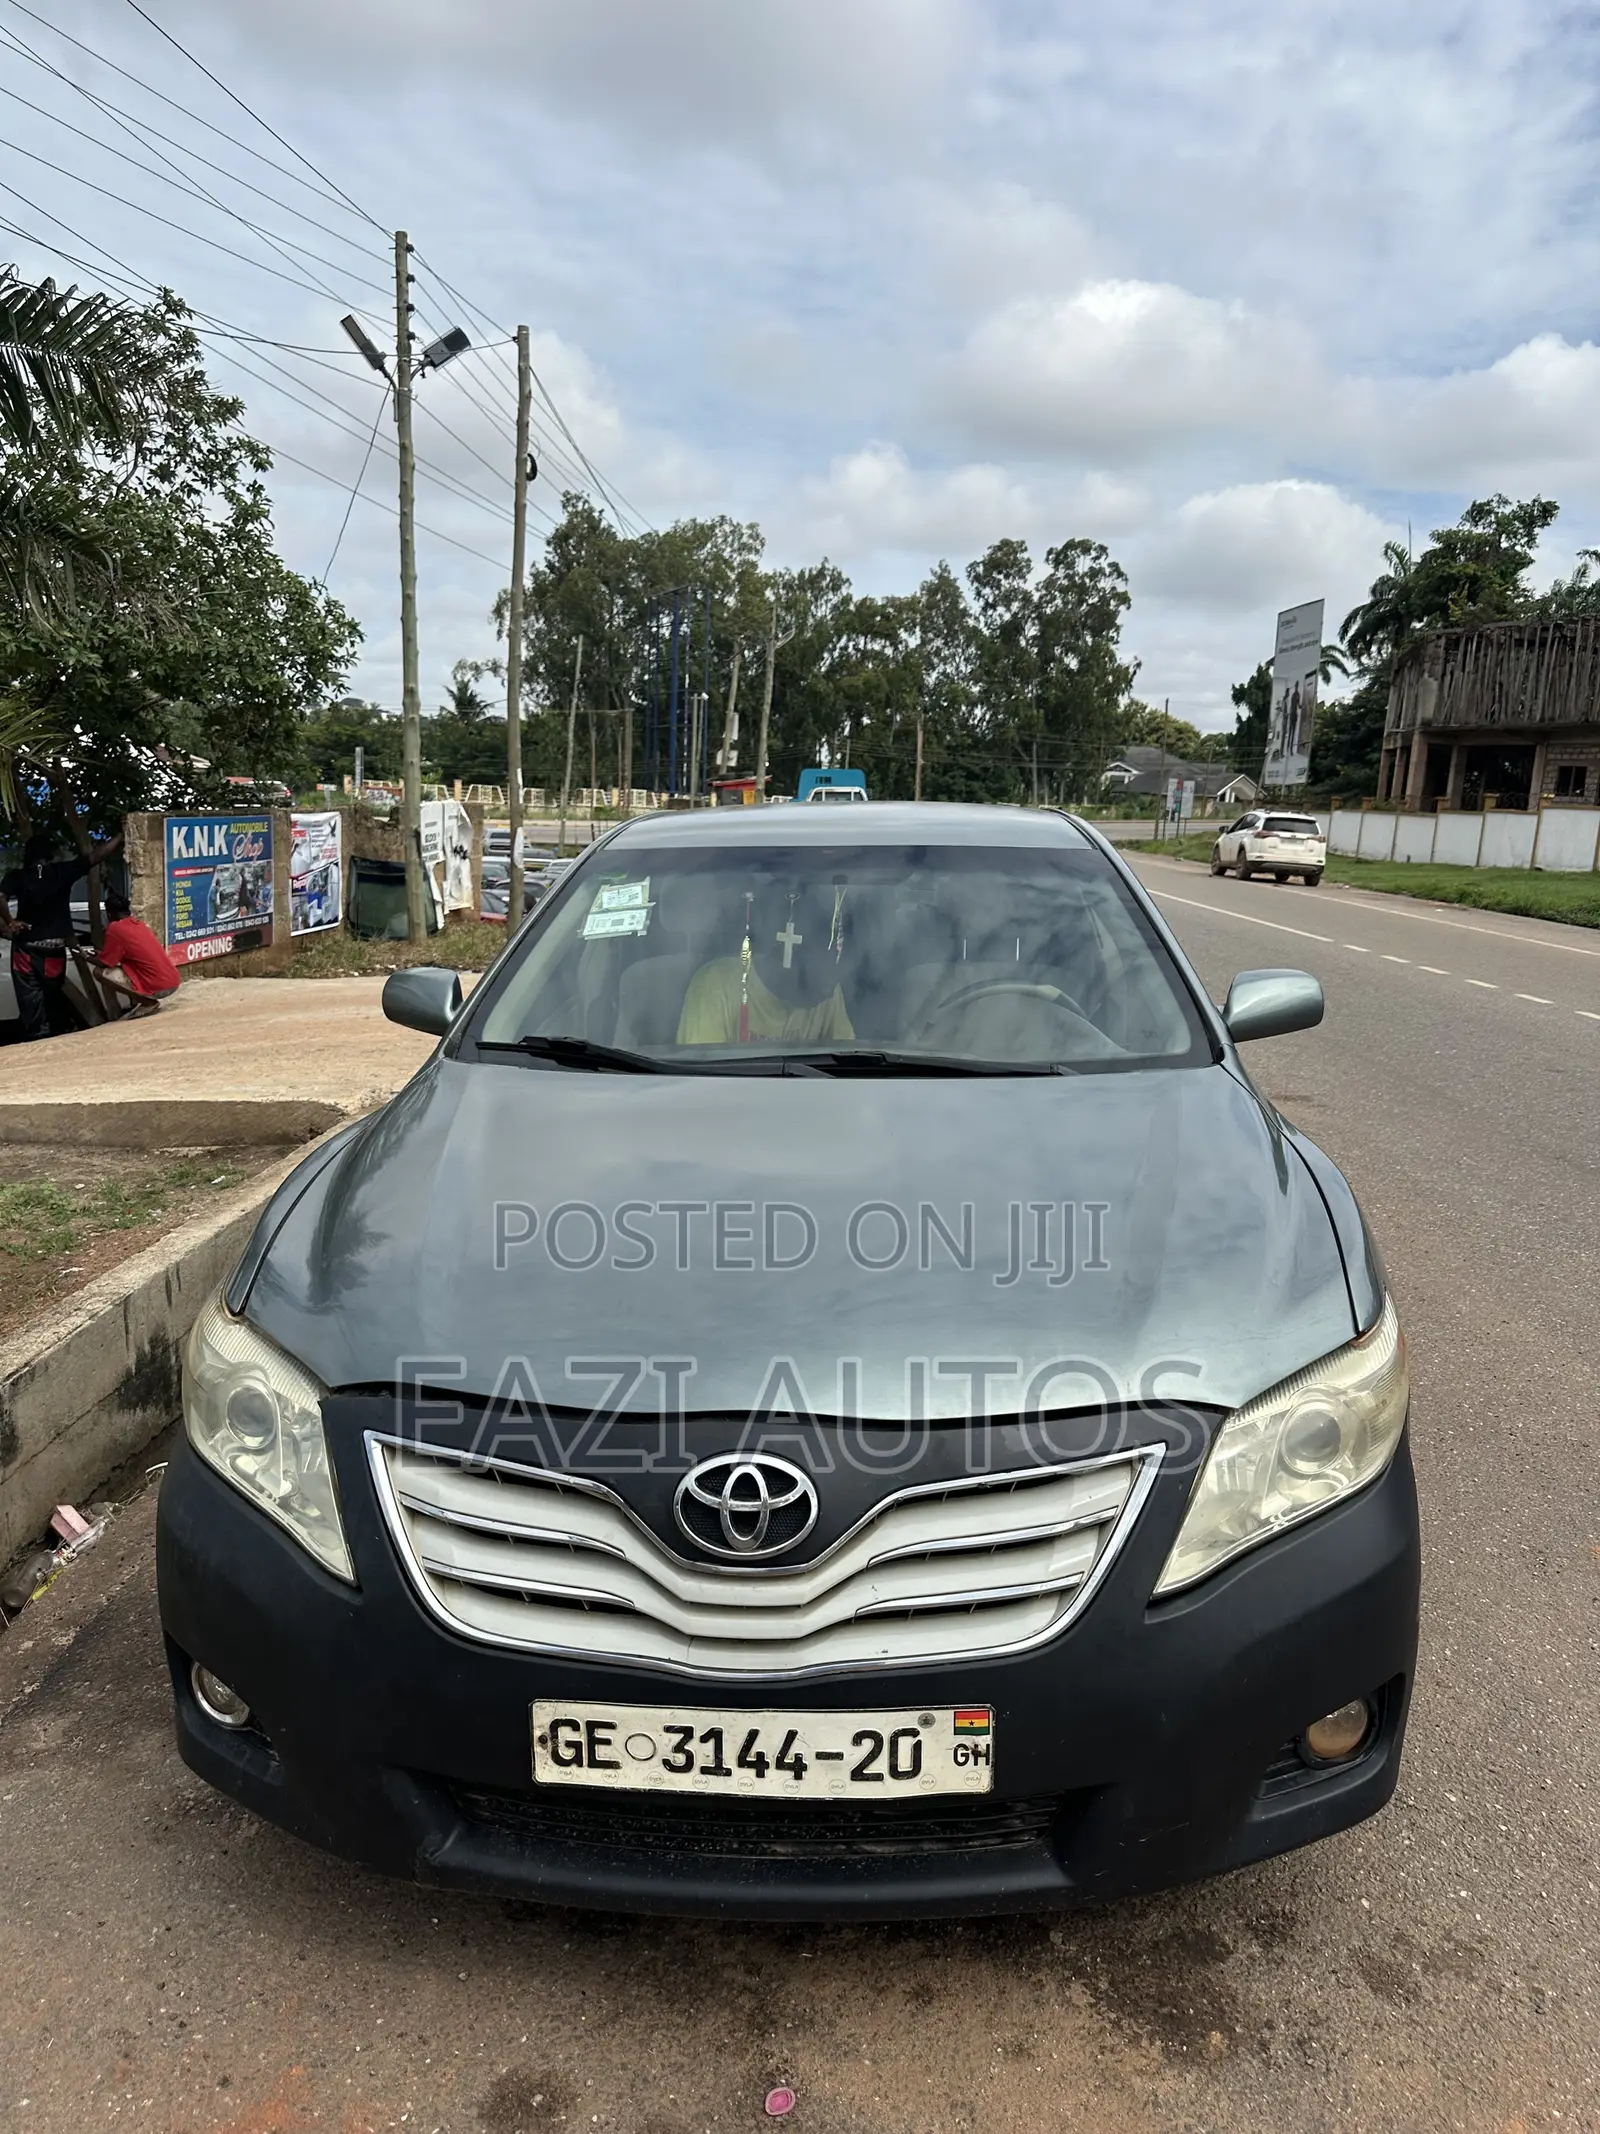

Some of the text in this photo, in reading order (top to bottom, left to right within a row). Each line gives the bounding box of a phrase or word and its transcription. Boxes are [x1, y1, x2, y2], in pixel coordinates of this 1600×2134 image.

[230, 822, 268, 833] AUTOMOBILE
[173, 825, 228, 859] K.N.K
[233, 830, 263, 864] Shop
[176, 896, 191, 904] DODGE
[176, 904, 193, 912] TOYOTA
[176, 920, 192, 928] NISSAN
[175, 932, 186, 940] TEL:
[187, 936, 232, 960] OPENING
[548, 1716, 923, 1782] GE 3144-20
[953, 1743, 991, 1767] GH
